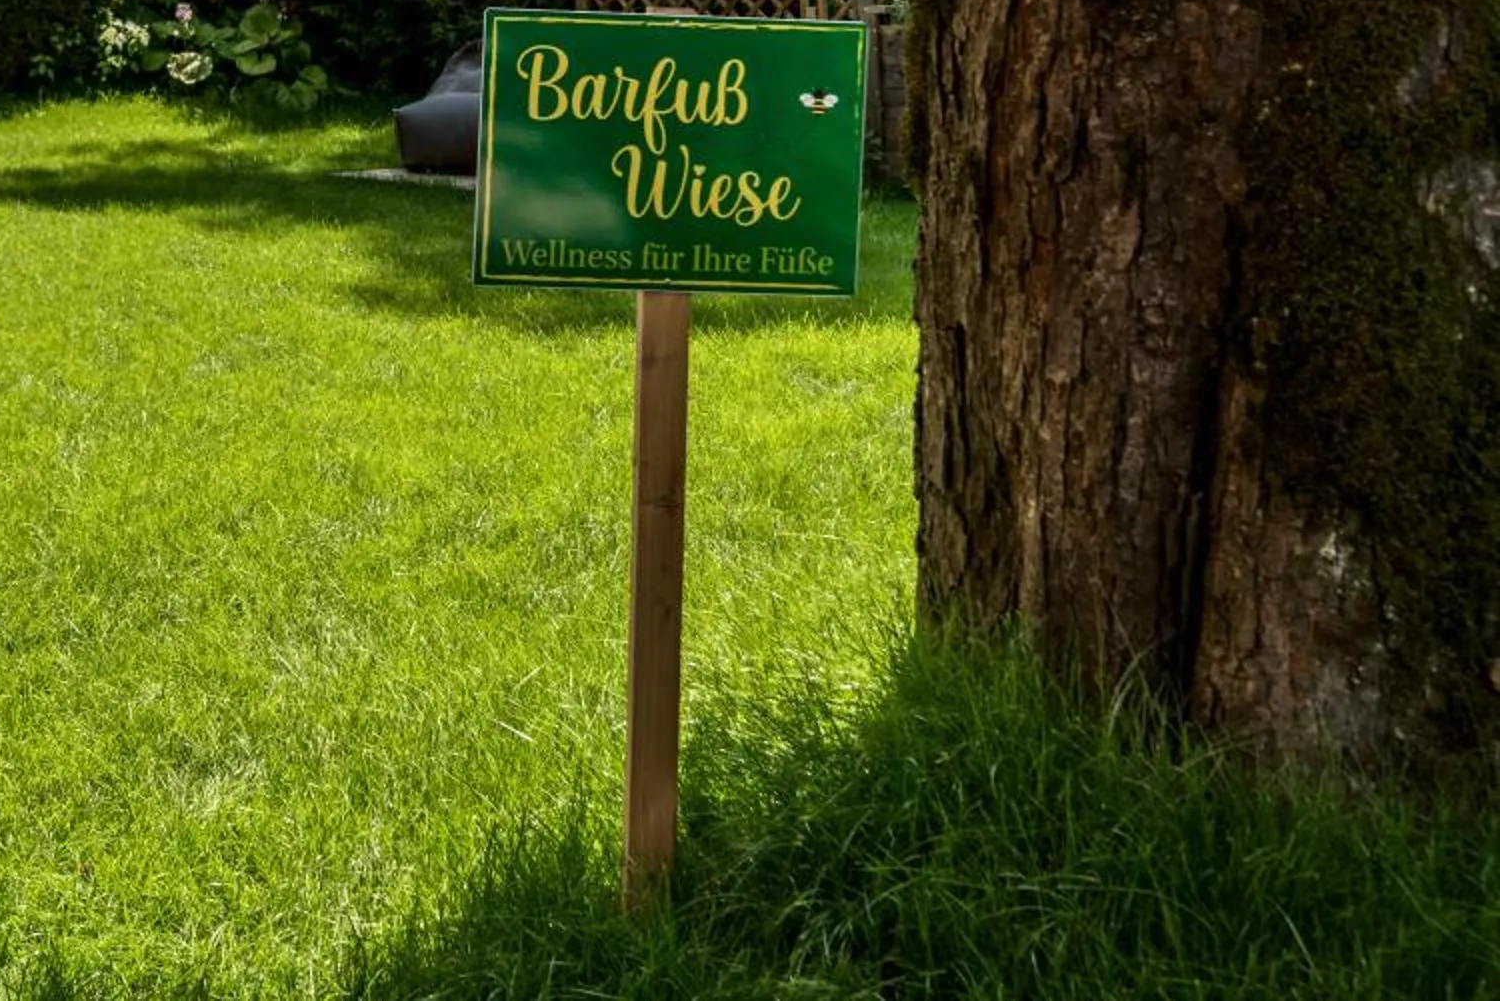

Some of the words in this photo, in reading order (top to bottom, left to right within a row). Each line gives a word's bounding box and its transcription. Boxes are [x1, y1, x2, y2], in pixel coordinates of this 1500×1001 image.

[516, 44, 749, 155] Barfuß
[611, 144, 801, 227] Wiese
[502, 239, 632, 269] Wellness
[640, 242, 685, 271] für
[692, 244, 752, 273] Ihre
[760, 246, 835, 276] Füße
